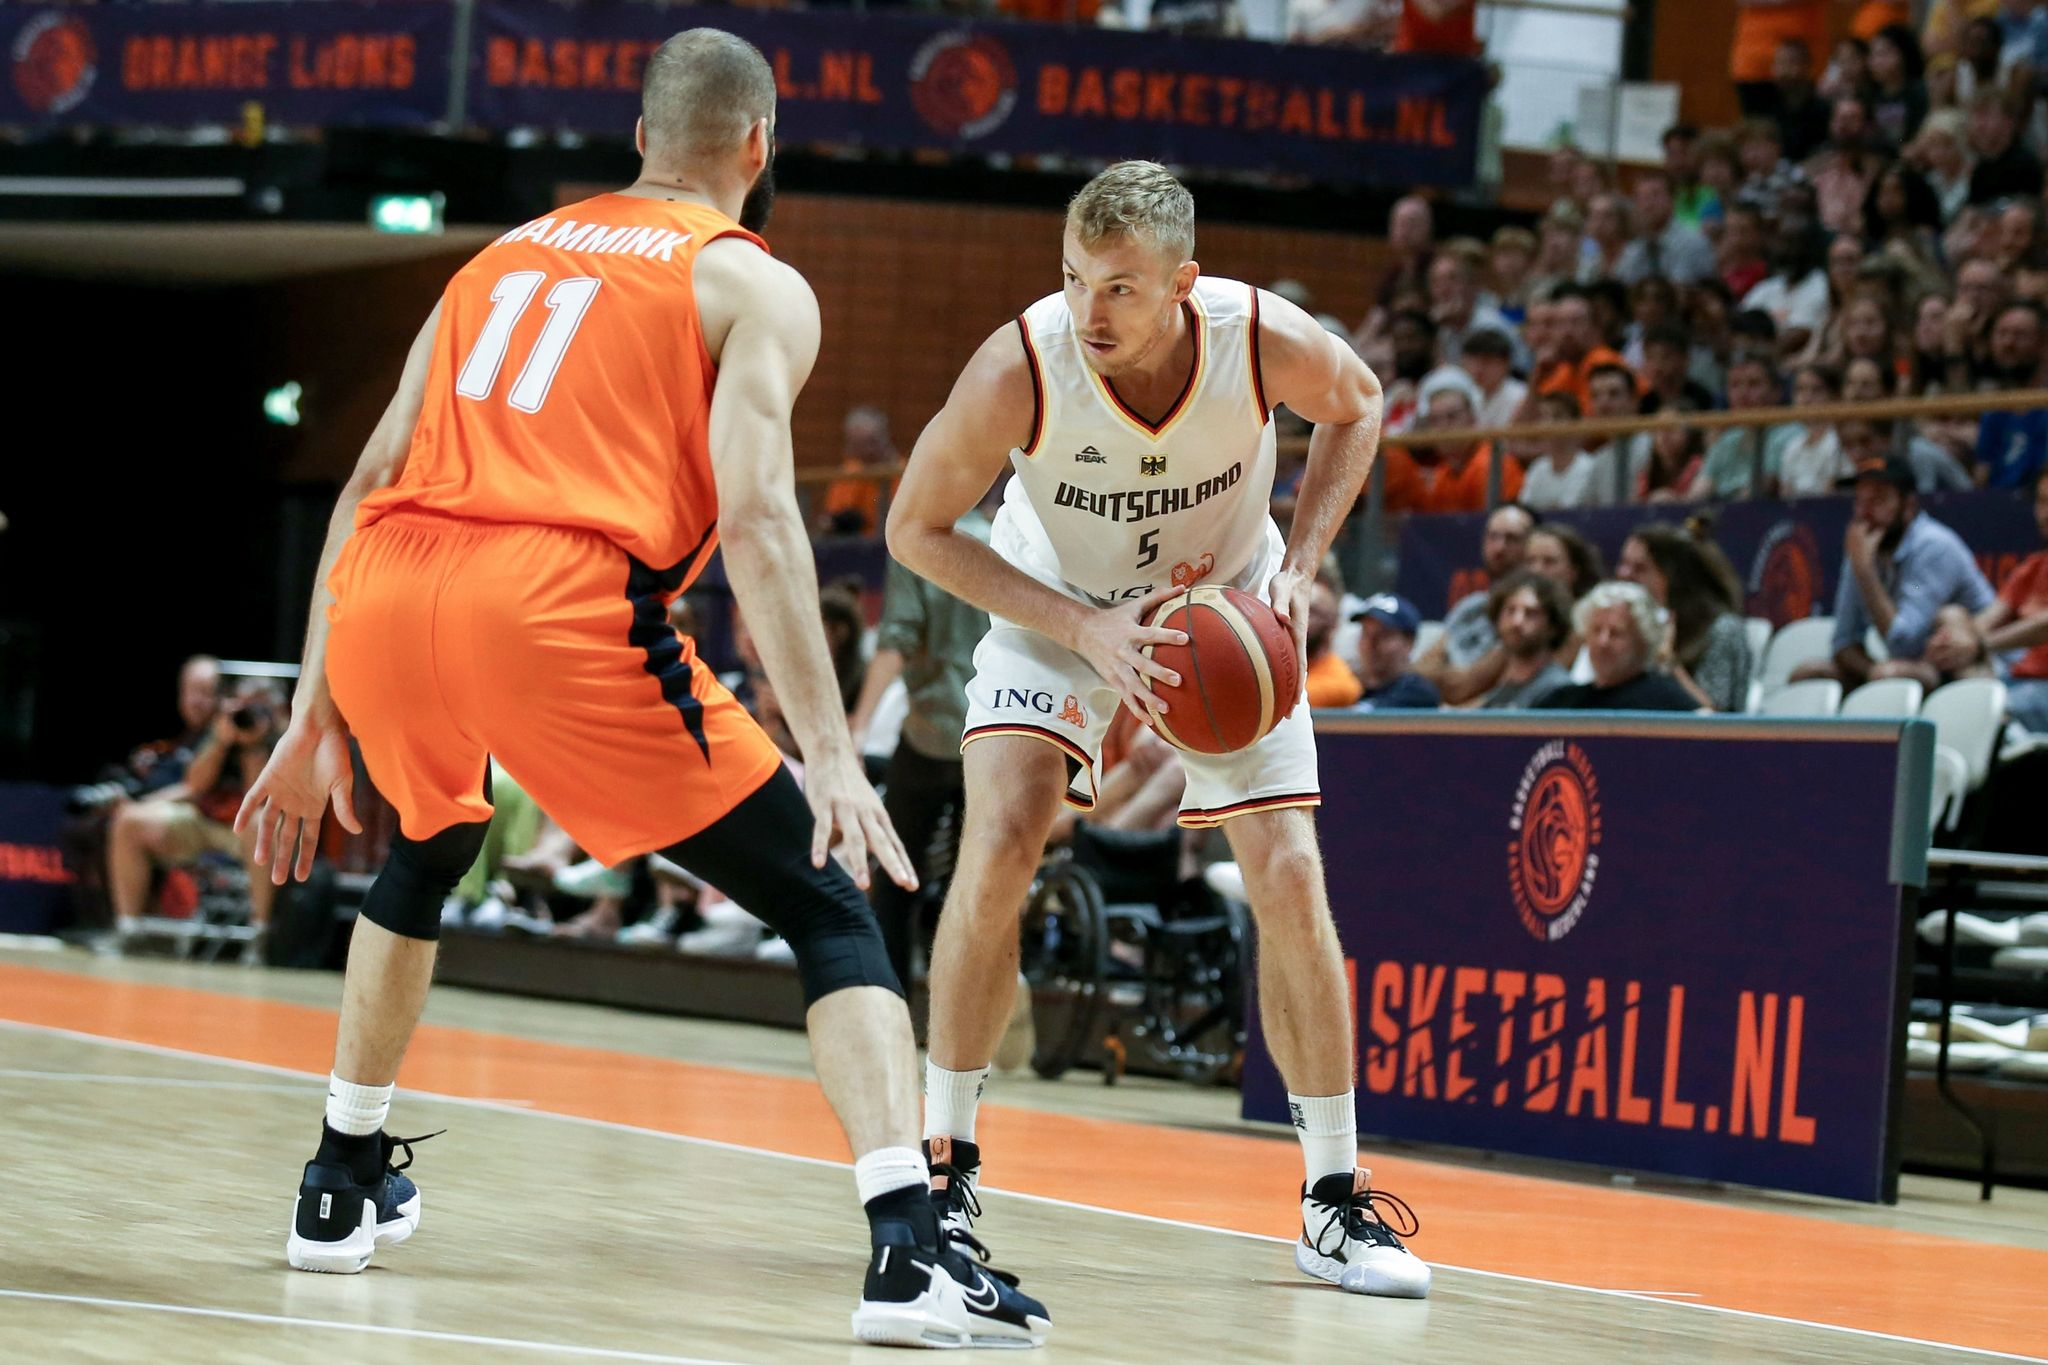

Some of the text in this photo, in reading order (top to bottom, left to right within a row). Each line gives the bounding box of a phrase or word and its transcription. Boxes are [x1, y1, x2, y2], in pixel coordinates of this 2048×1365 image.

[1036, 63, 1457, 148] BASKETBALL.NL
[456, 271, 602, 414] 11
[1075, 453, 1108, 464] PEAK
[1054, 461, 1242, 523] DEUTSCHLAND
[1136, 528, 1160, 569] 5
[992, 688, 1055, 714] ING
